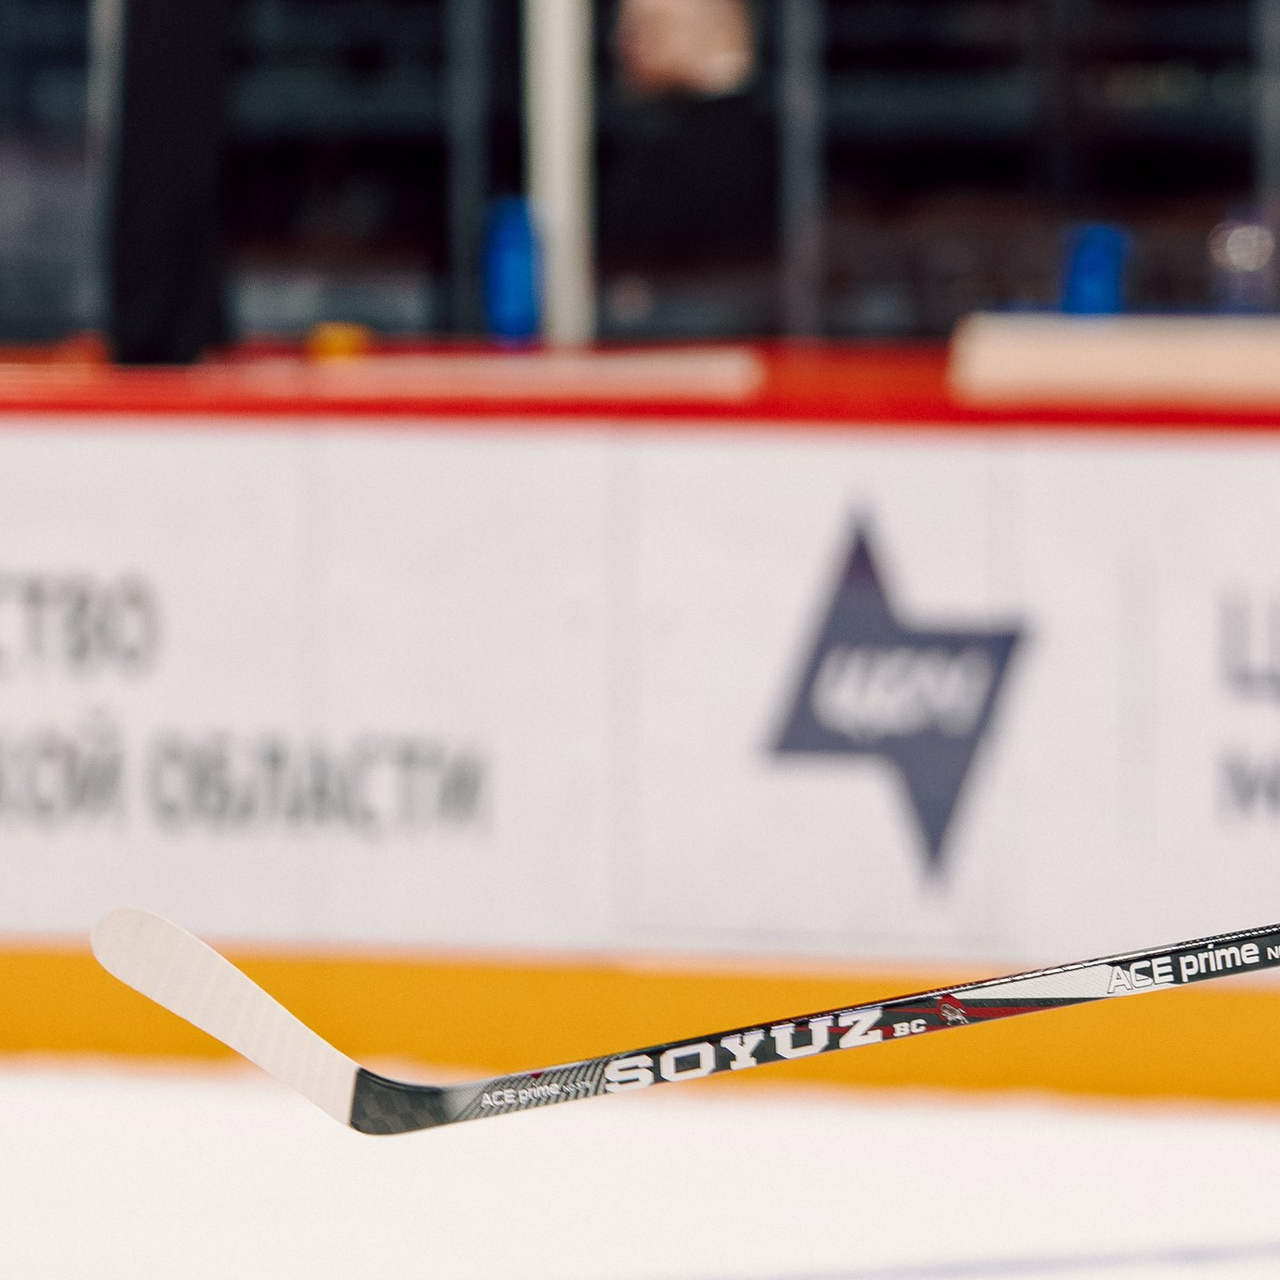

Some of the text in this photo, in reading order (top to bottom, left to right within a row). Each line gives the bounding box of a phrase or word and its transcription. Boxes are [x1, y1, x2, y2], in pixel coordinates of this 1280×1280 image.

[1107, 955, 1174, 993] ACE
[1179, 942, 1260, 983] prime
[603, 1007, 884, 1094] SOYUZ
[480, 1087, 520, 1109] ACE
